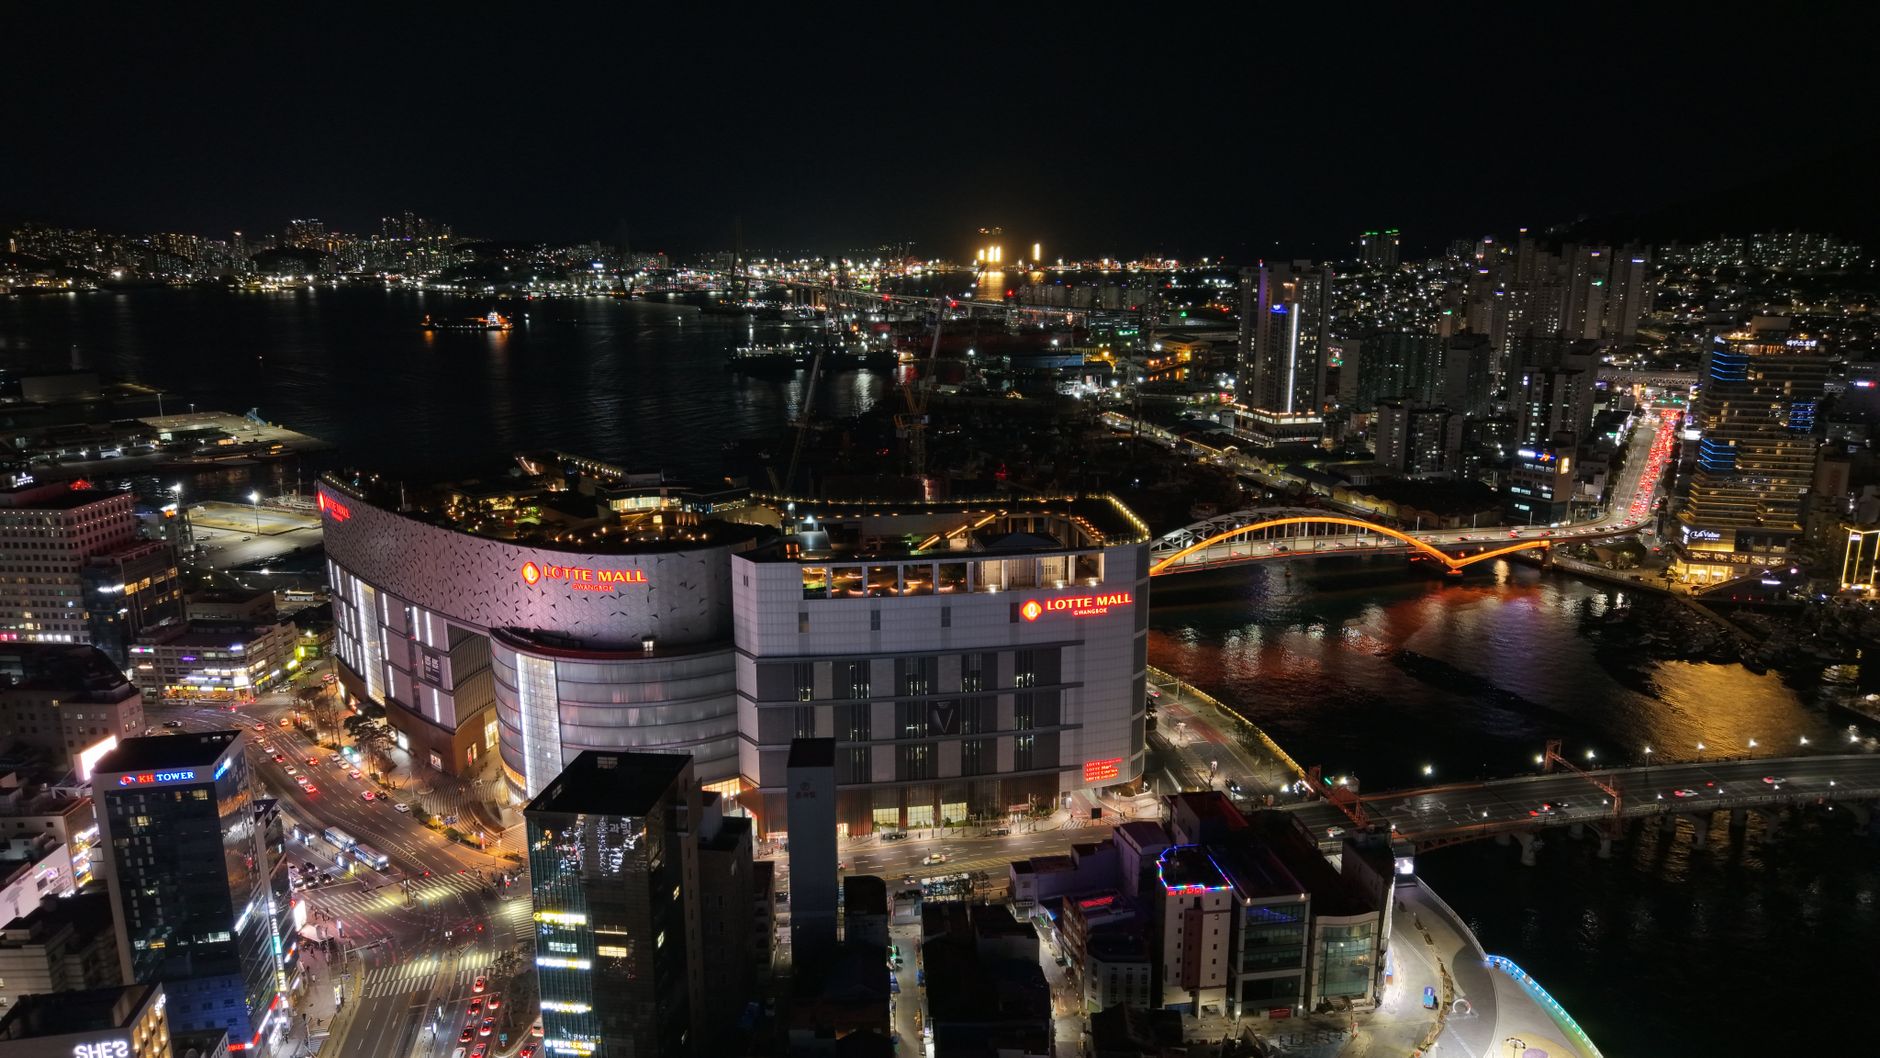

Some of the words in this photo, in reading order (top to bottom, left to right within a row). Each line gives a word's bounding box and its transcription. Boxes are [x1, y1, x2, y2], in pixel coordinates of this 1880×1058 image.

[543, 565, 592, 581] LOTTE
[598, 570, 647, 583] MALL
[1047, 597, 1092, 611] LOTTE
[1096, 593, 1132, 606] MALL
[138, 774, 154, 783] KH
[156, 771, 194, 782] TOWER
